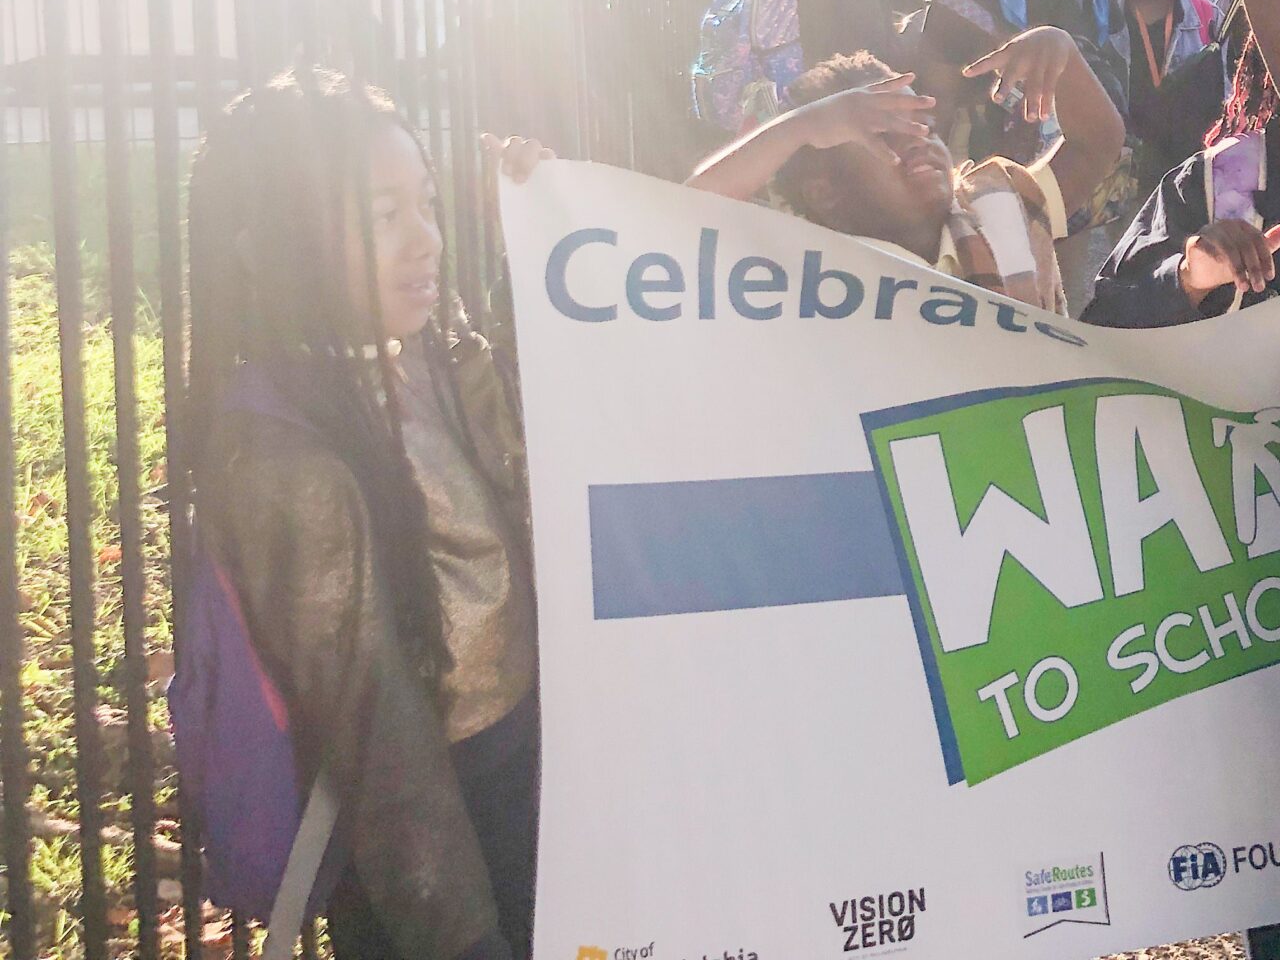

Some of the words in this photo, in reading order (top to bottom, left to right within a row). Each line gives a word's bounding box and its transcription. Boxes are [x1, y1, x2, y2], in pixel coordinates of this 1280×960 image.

[977, 656, 1079, 739] TO
[829, 887, 926, 927] VISION
[640, 941, 655, 959] of
